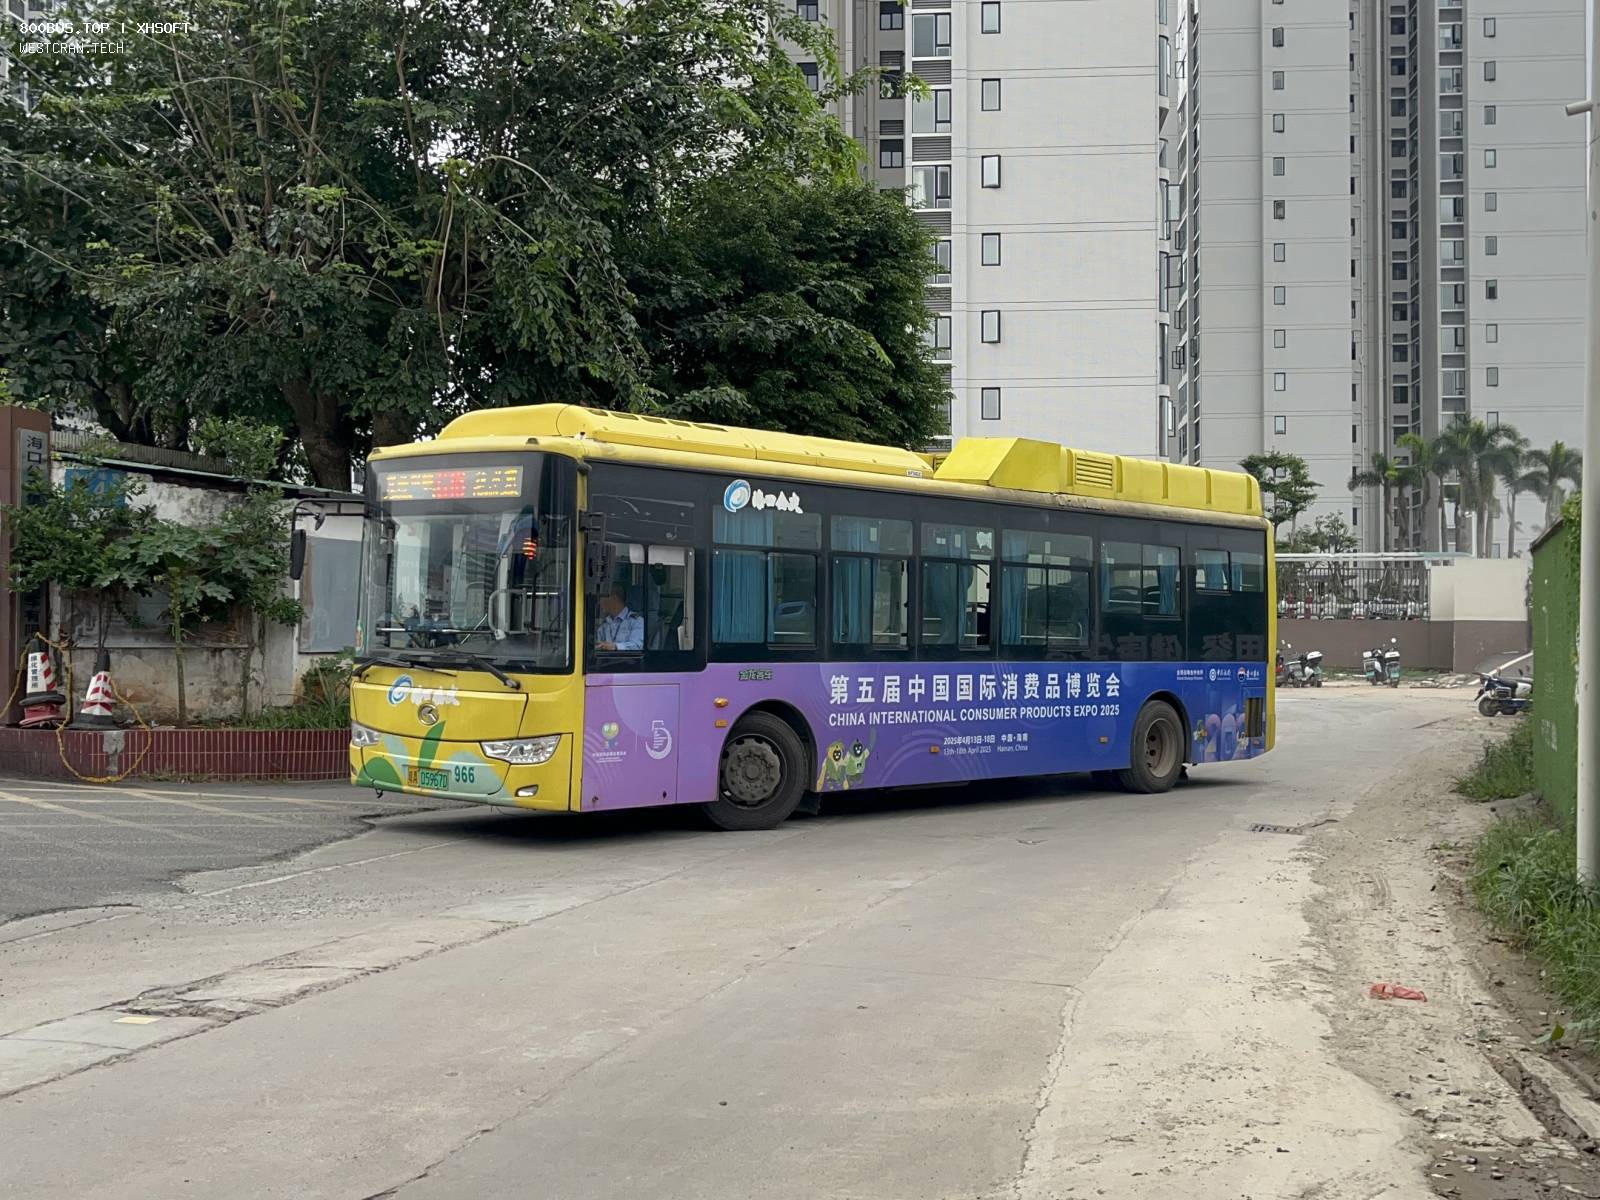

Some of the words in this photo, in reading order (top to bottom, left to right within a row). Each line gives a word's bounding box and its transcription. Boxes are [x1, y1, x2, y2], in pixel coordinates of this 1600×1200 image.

[829, 672, 1121, 705] 第五届中国国际消费品博览会
[829, 712, 866, 726] CHINA
[869, 709, 957, 725] INTERNATIONAL
[960, 707, 1018, 721] CONSUMER
[1020, 705, 1071, 719] PRODUCTS
[1073, 704, 1098, 717] EXPO
[1100, 704, 1120, 716] 2025
[454, 765, 475, 783] 966
